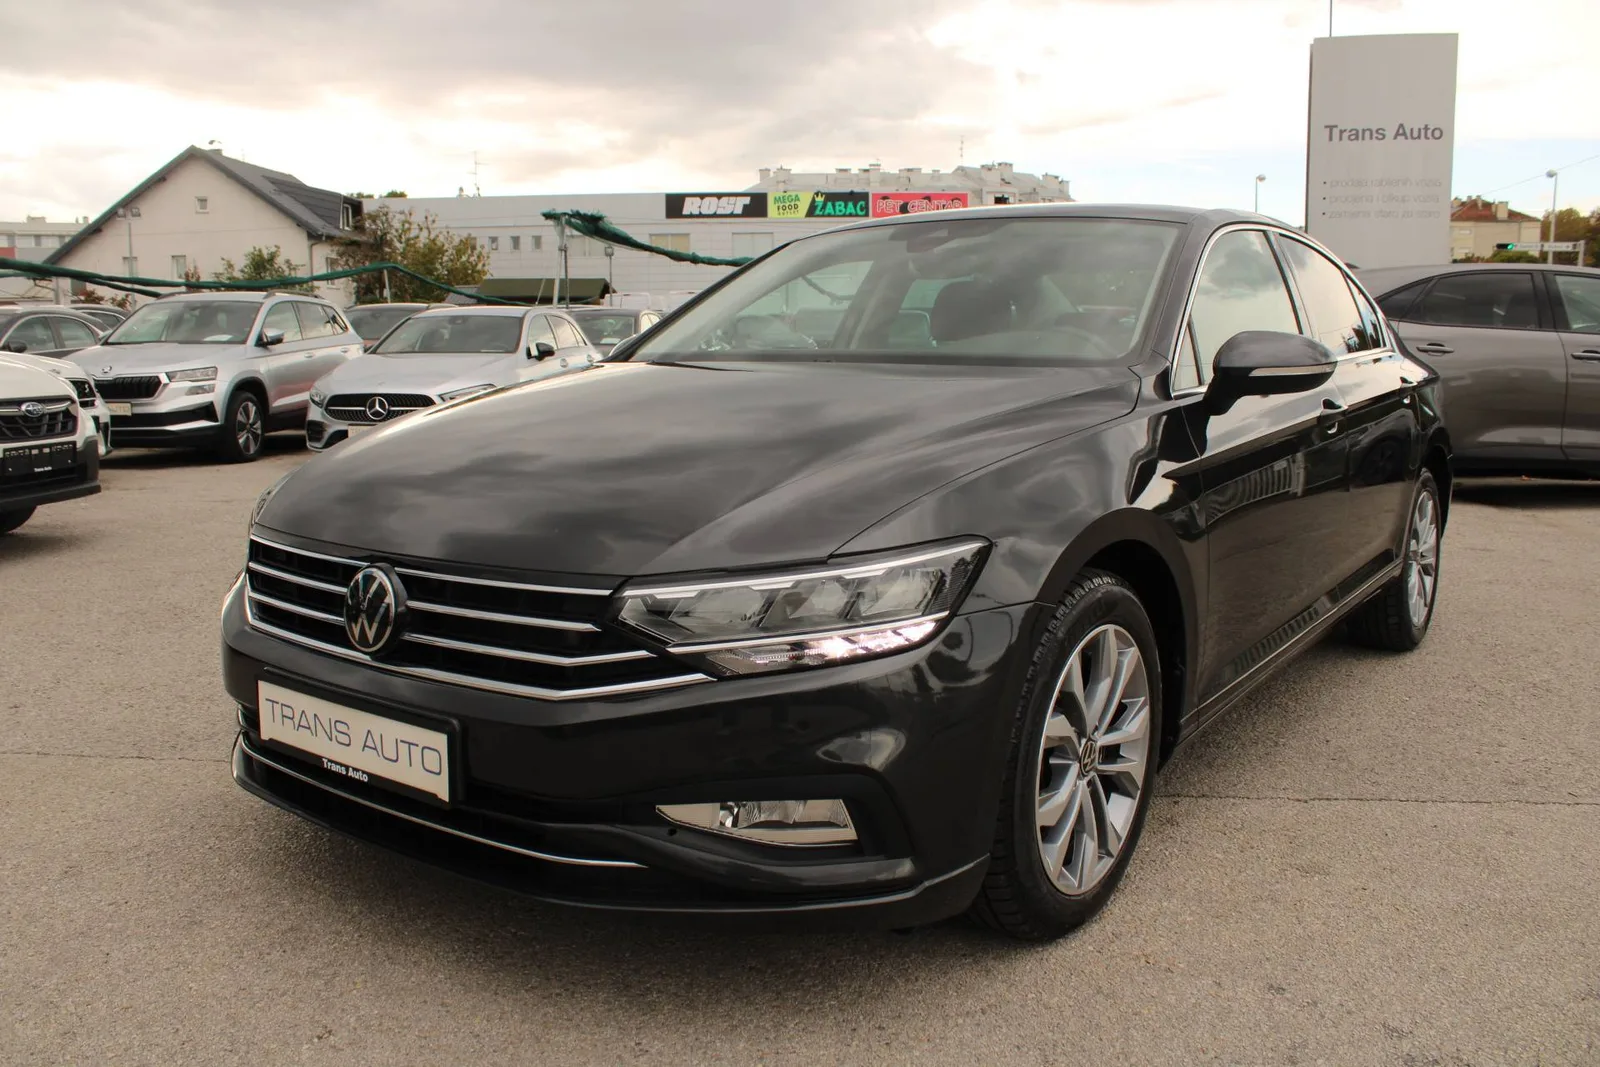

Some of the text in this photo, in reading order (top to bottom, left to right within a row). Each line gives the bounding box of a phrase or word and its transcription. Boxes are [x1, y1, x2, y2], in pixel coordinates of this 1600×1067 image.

[1324, 123, 1444, 142] Trans Auto
[773, 194, 801, 205] MEGA
[777, 203, 799, 211] FOOD
[877, 199, 903, 213] PET
[265, 698, 442, 776] TRANS AUTO
[322, 758, 369, 782] Trans Auto
